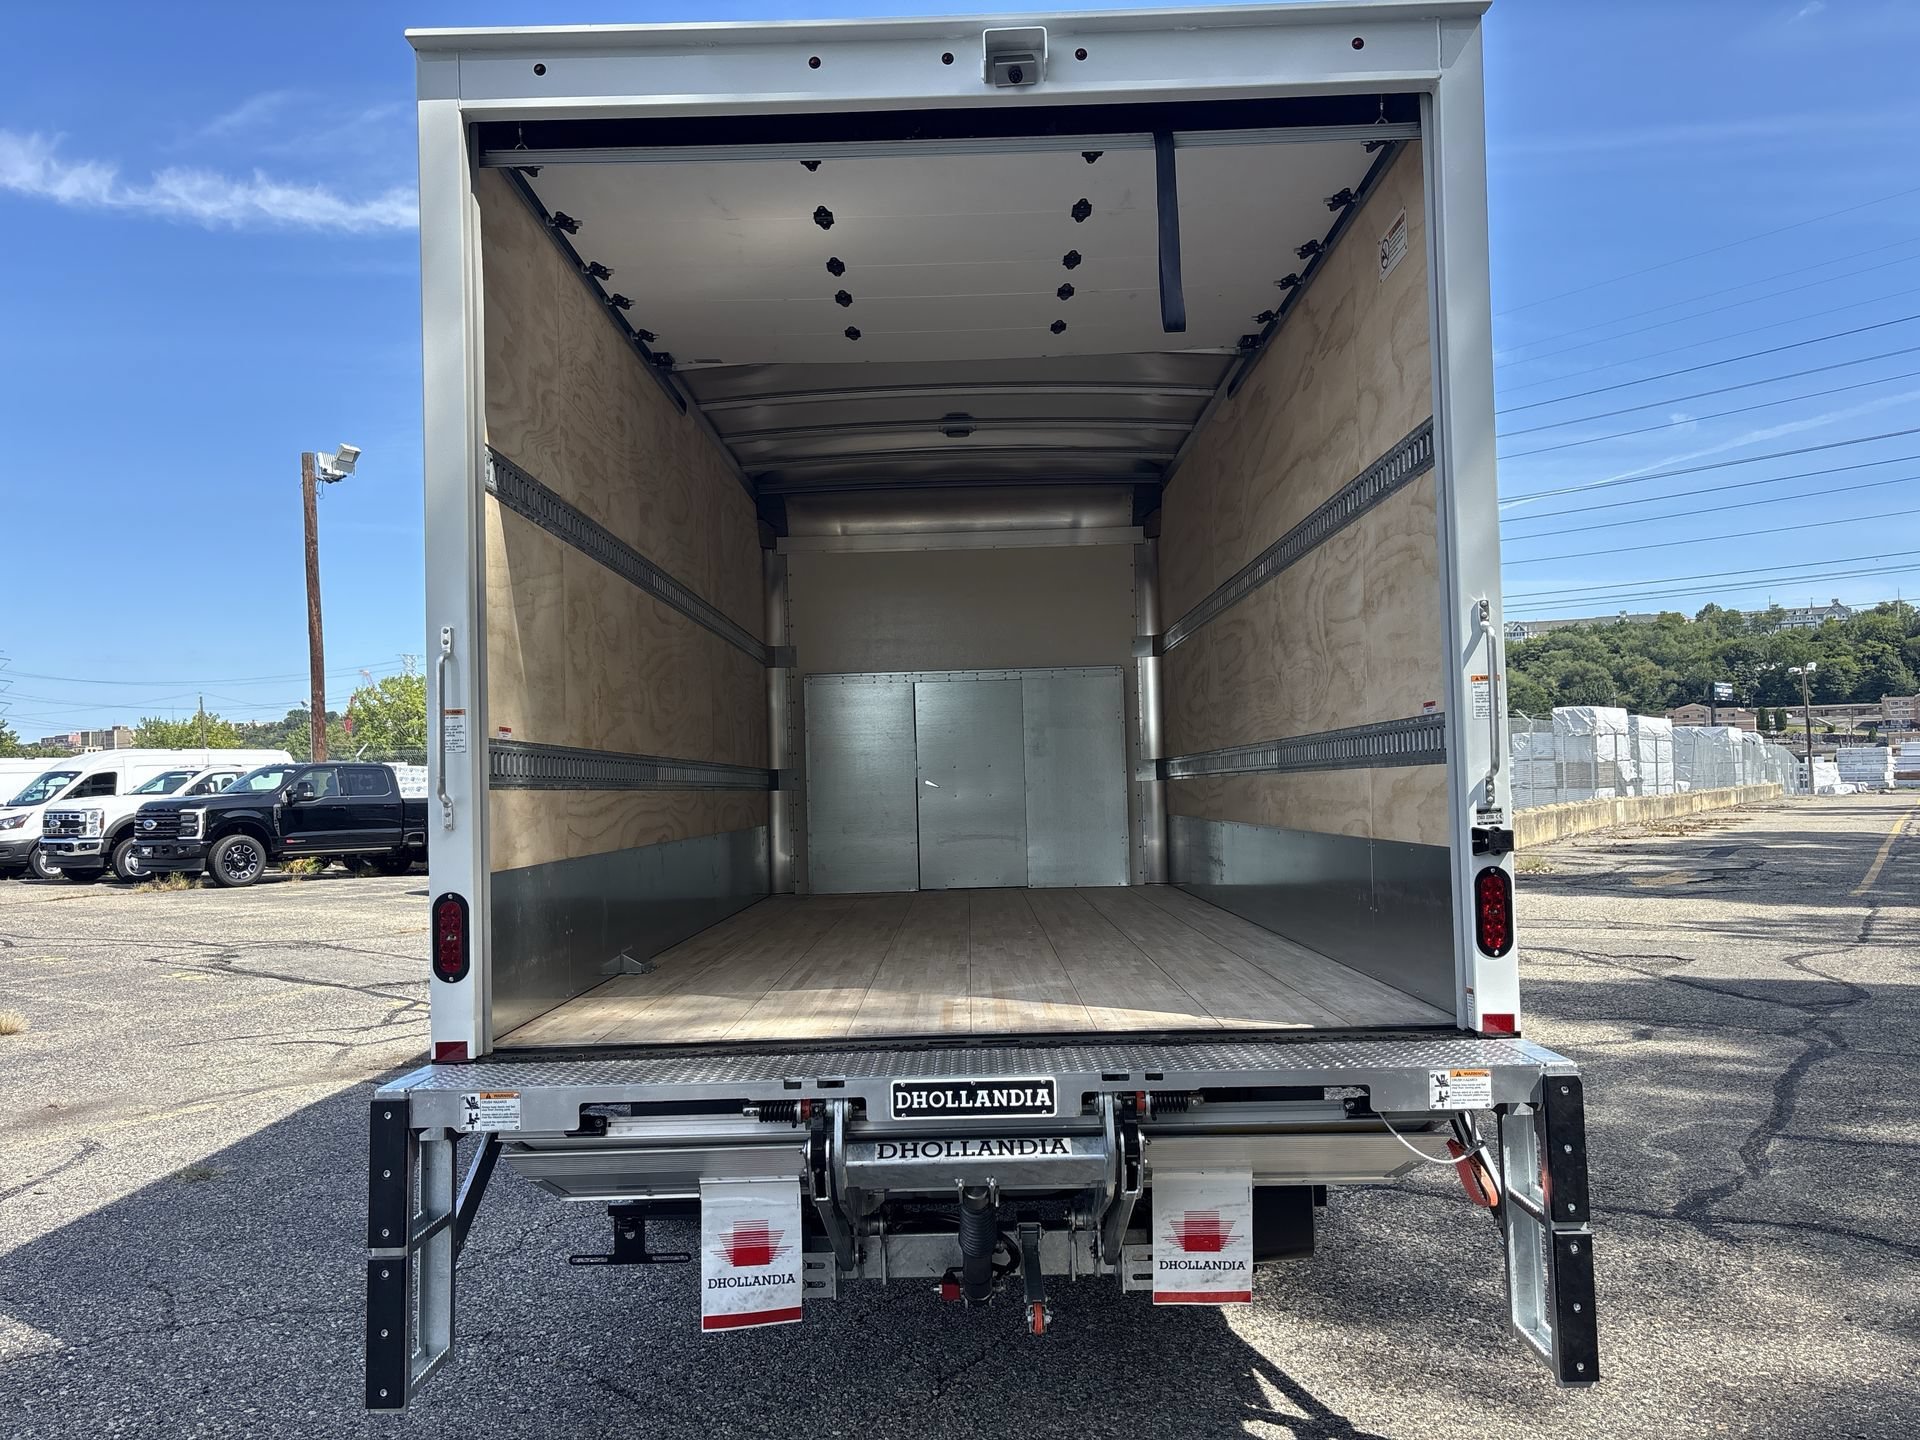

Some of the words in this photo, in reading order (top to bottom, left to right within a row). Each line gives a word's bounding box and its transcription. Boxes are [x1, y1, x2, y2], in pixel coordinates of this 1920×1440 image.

[896, 1088, 1052, 1109] DHOLLANDIA
[877, 1138, 1069, 1159] DHOLLANDIA
[1159, 1261, 1246, 1270] DHOLLANDIA
[708, 1273, 796, 1289] DHOLLANDIA
